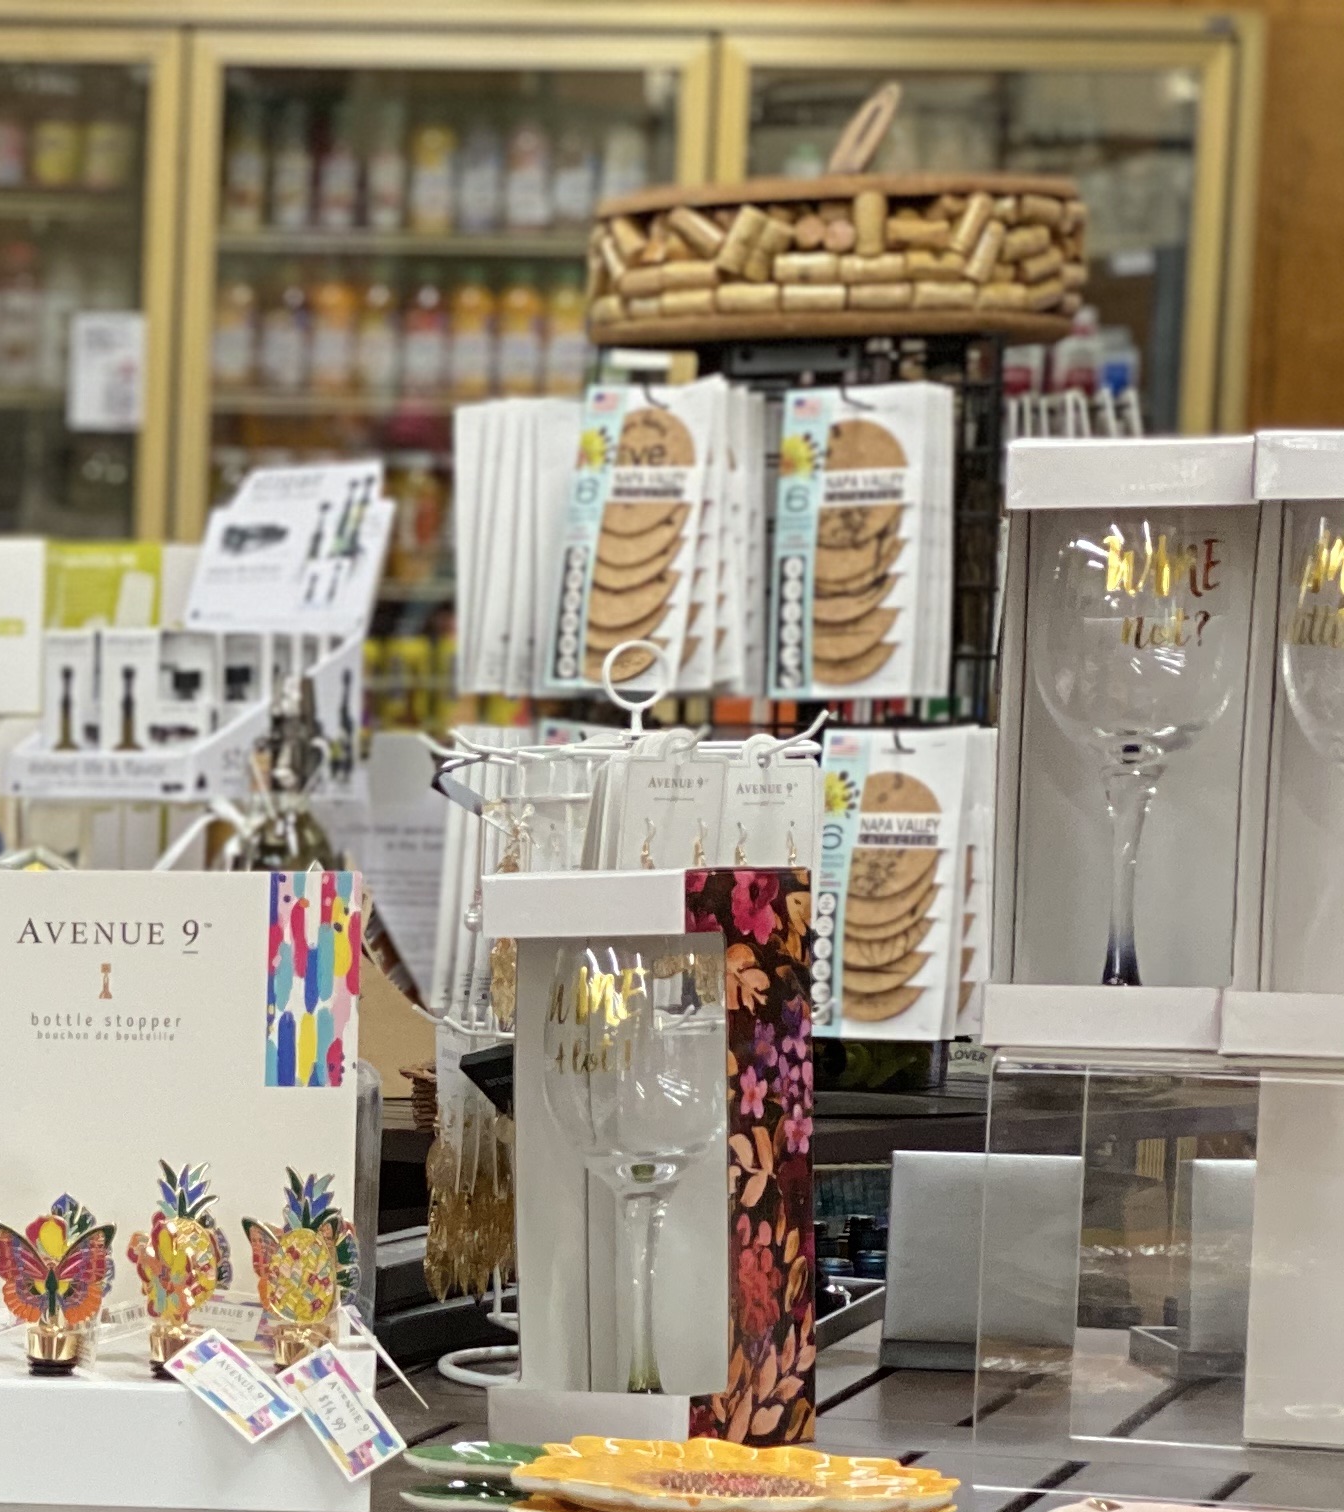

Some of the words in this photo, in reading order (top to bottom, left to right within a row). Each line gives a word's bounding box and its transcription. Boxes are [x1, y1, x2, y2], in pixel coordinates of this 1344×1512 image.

[648, 776, 693, 789] AVENUE
[735, 782, 783, 795] AVENUE
[860, 817, 895, 833] NAPA
[898, 817, 942, 834] VALLEY
[16, 917, 165, 946] AVENUE
[30, 1012, 93, 1028] bottle
[104, 1012, 182, 1032] stopper
[36, 1030, 89, 1041] bouchon
[95, 1030, 110, 1041] de
[115, 1030, 176, 1042] bouteille
[216, 1355, 256, 1394] AVENUE
